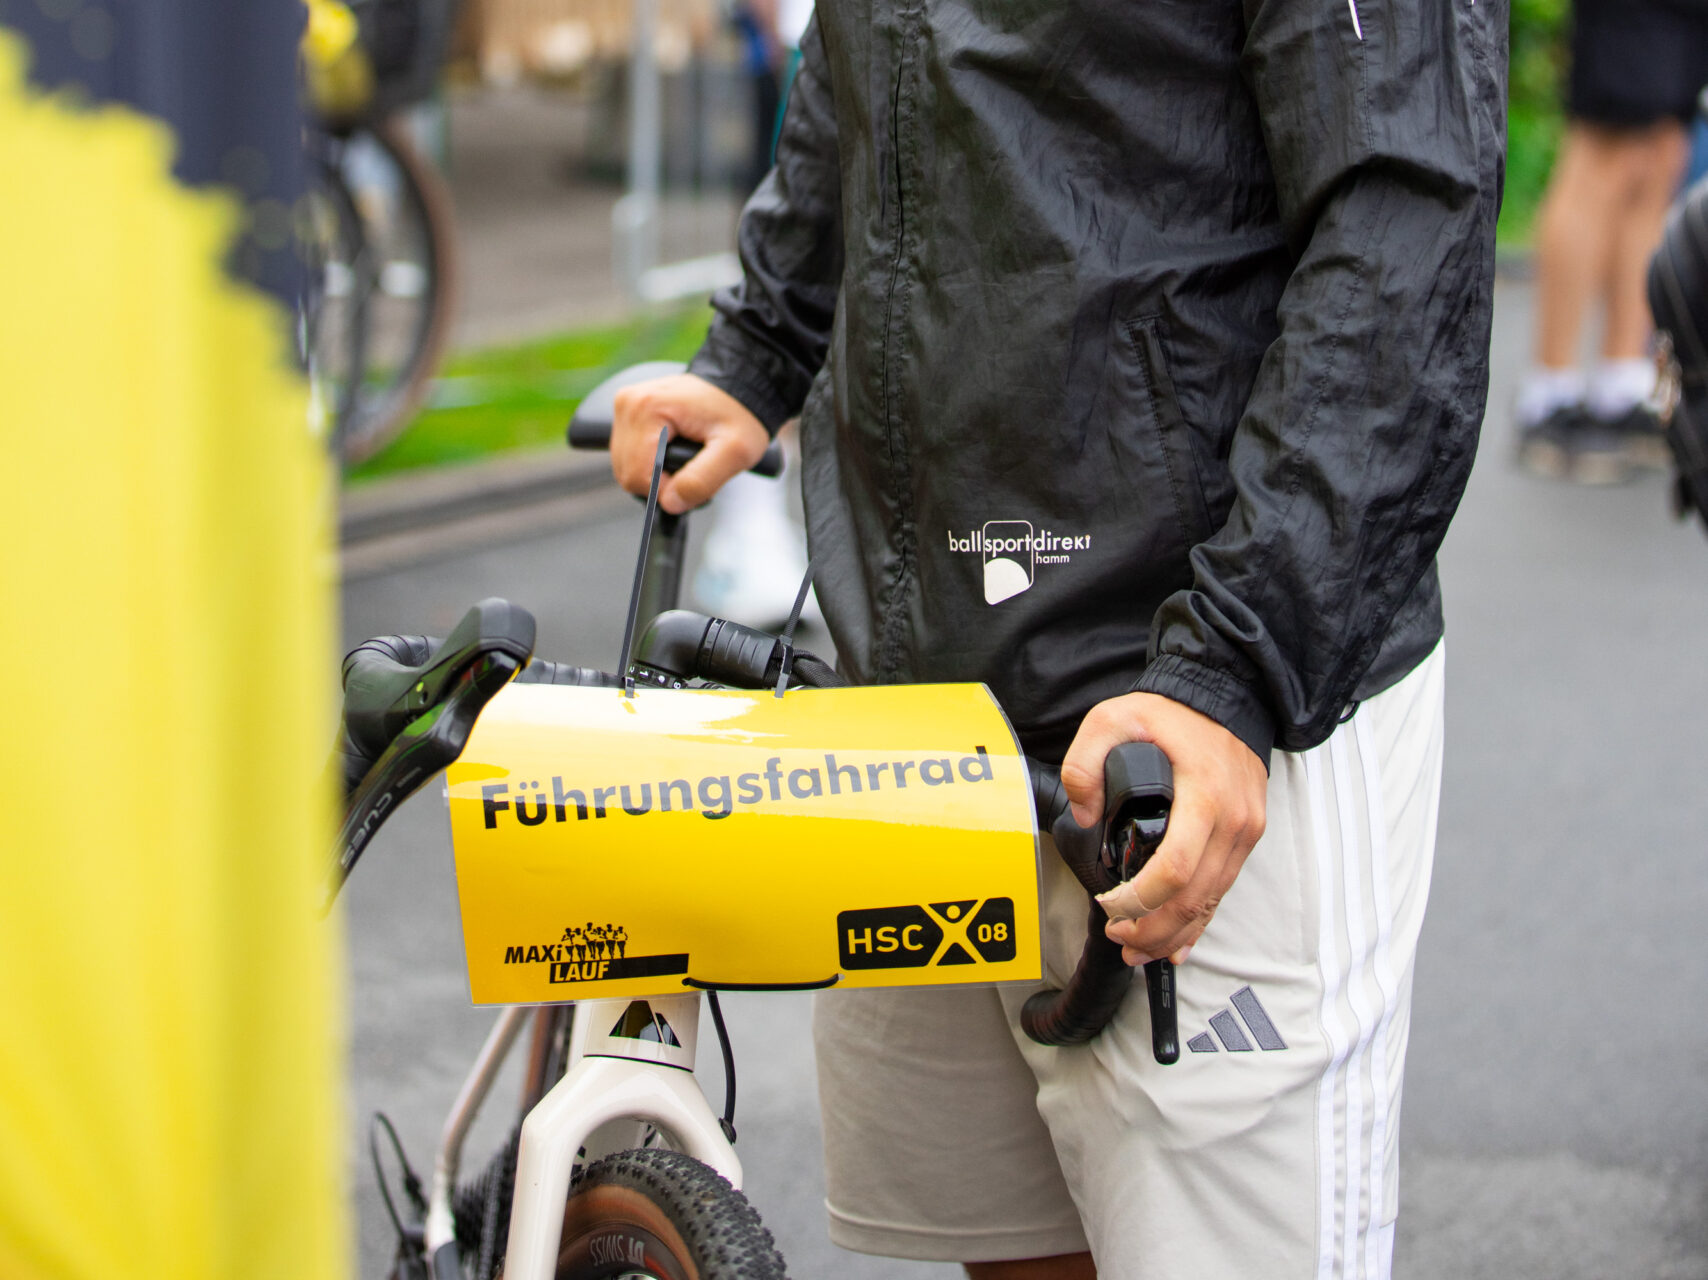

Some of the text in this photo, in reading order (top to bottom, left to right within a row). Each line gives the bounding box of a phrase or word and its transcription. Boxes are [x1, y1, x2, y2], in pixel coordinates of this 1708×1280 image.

[1035, 552, 1070, 564] hamm
[481, 746, 994, 829] Führungsfahrrad
[848, 923, 1008, 954] HSC 08
[554, 962, 609, 982] LAUF
[1161, 959, 1171, 1009] UES
[590, 1234, 624, 1266] SWISS
